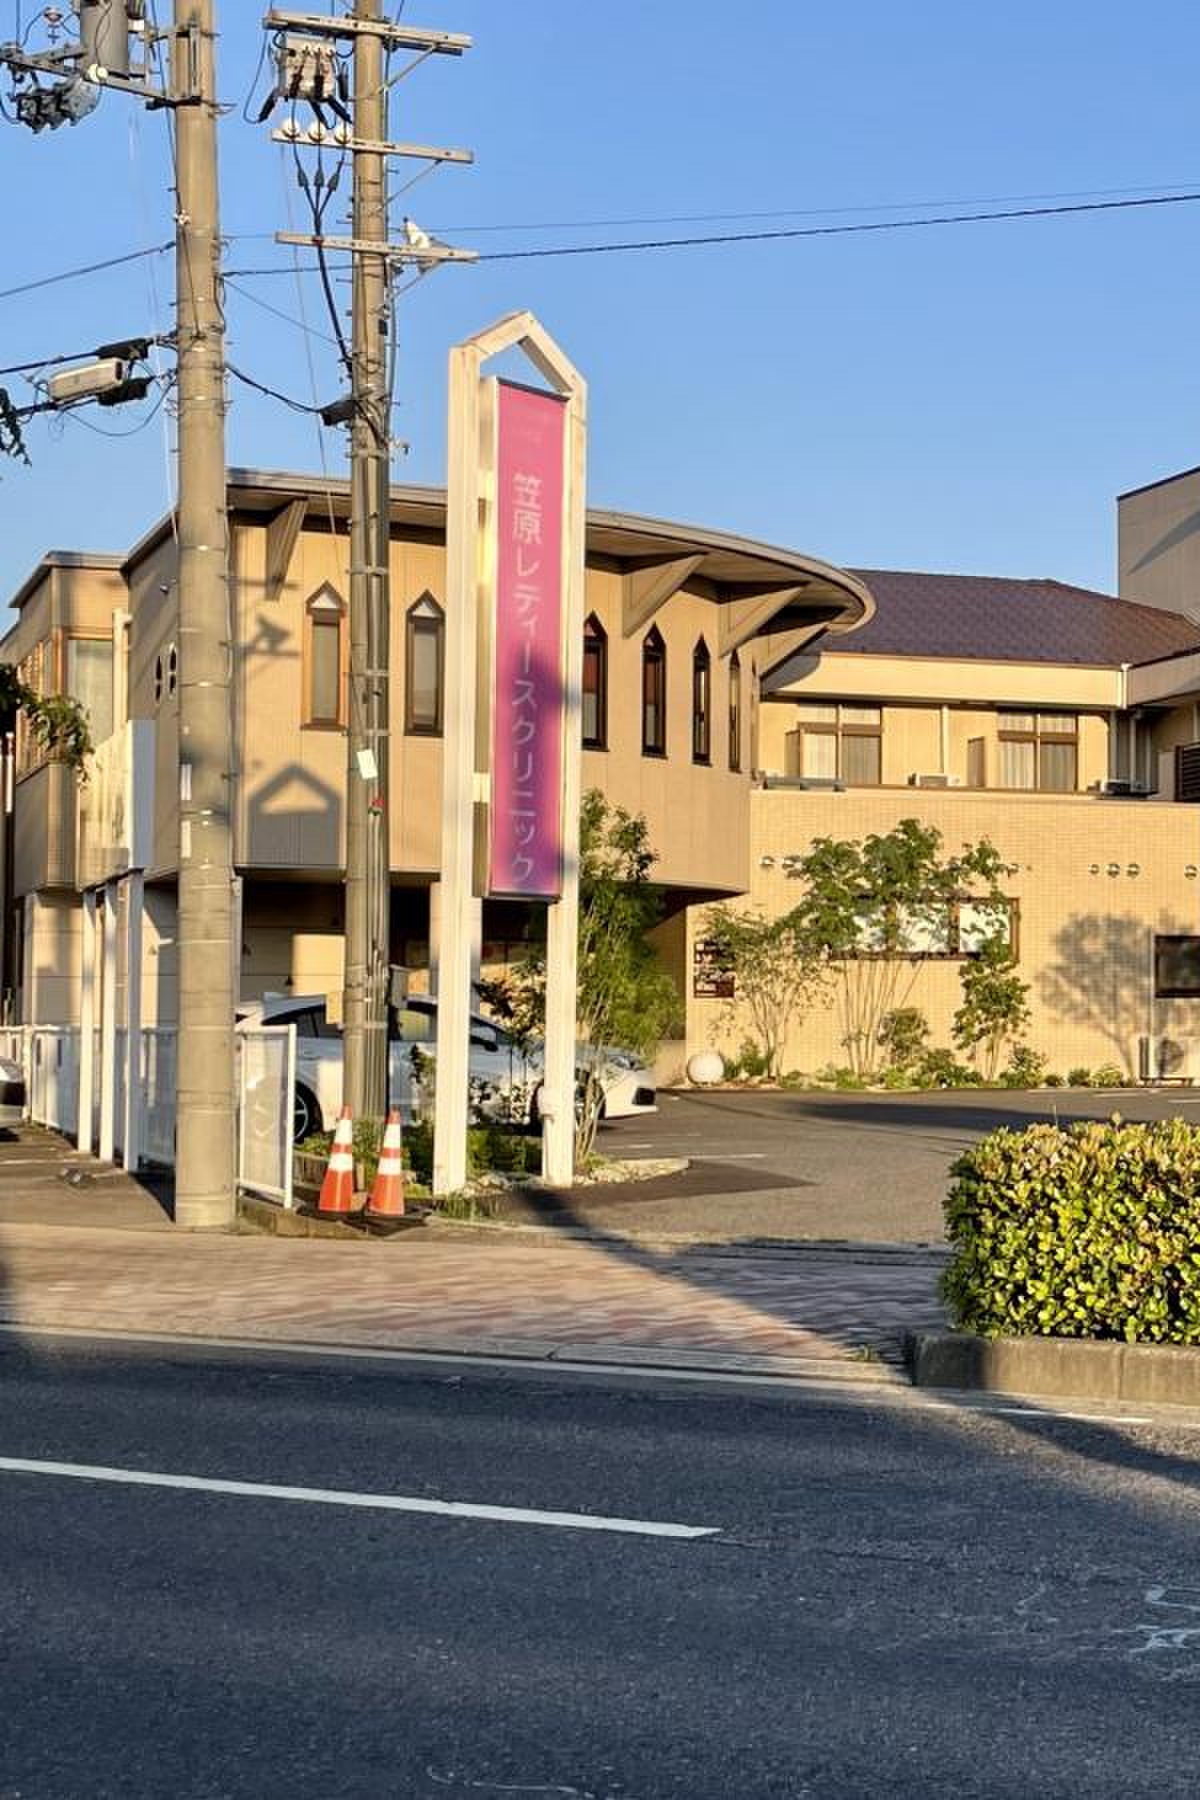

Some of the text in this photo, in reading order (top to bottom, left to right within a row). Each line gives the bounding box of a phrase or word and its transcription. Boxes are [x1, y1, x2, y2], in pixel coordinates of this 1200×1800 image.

[511, 472, 543, 882] 笠原レディースクリニック
